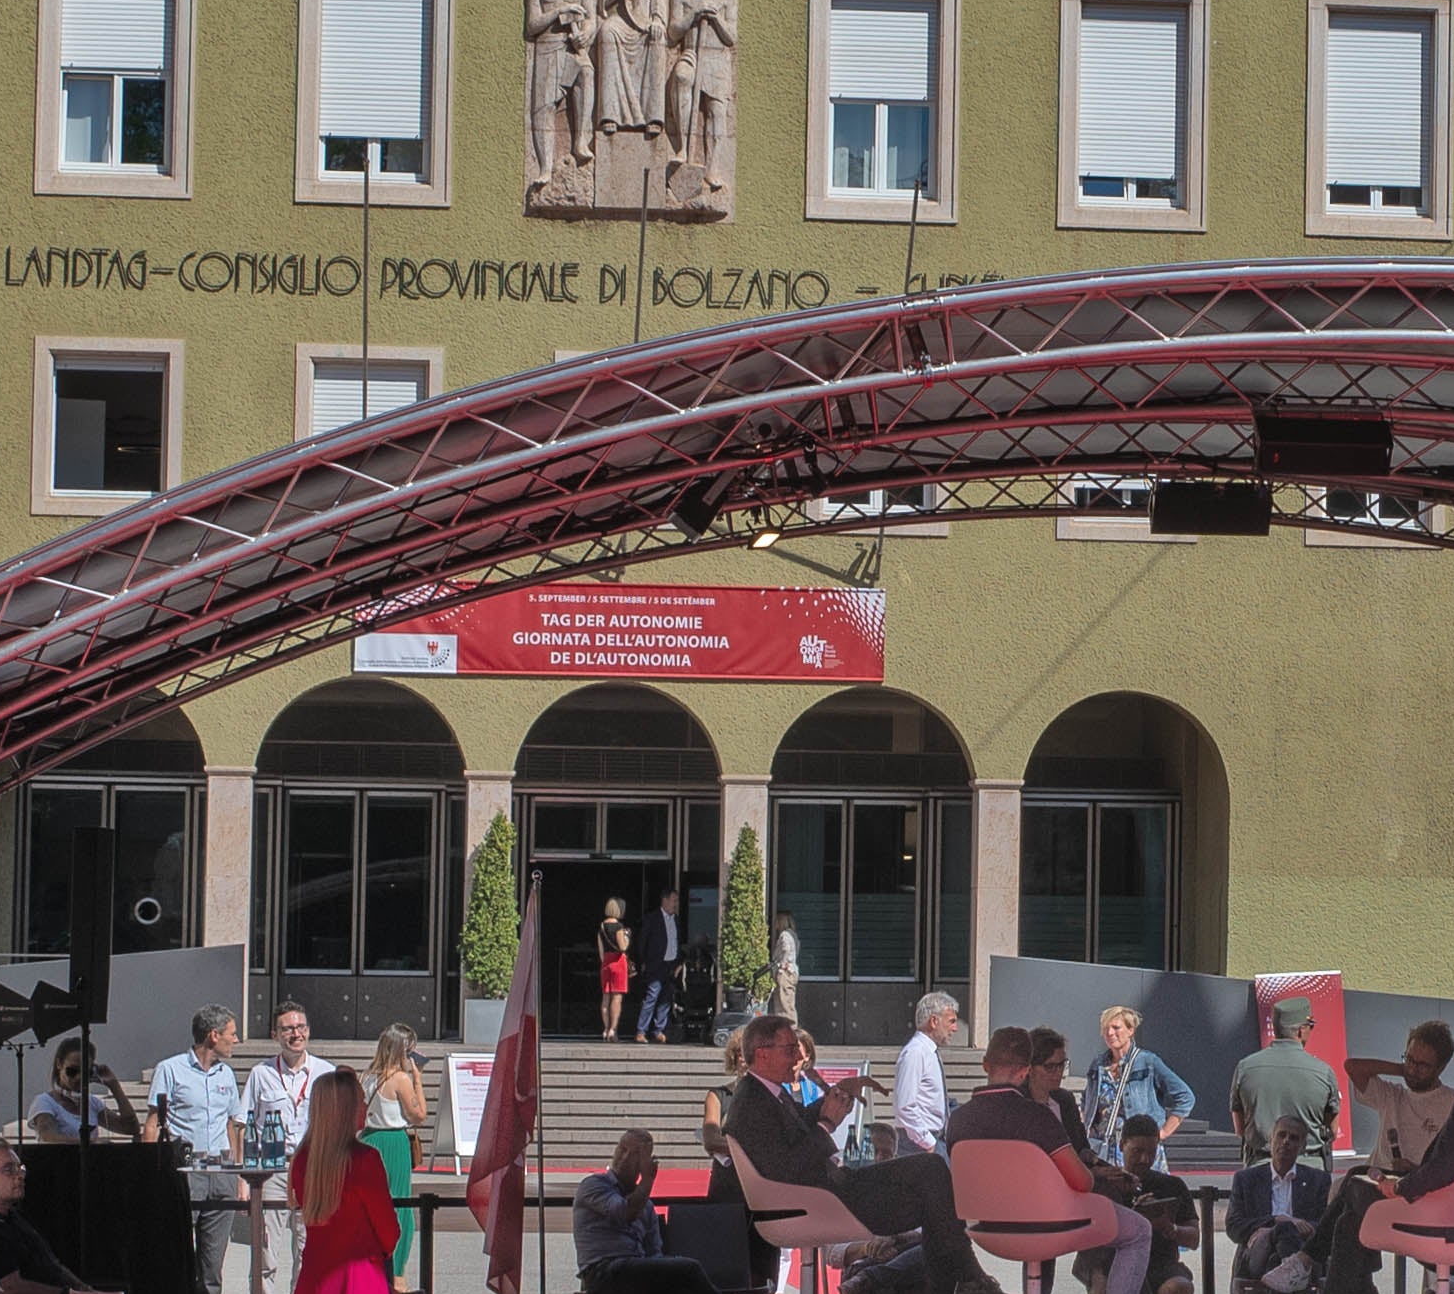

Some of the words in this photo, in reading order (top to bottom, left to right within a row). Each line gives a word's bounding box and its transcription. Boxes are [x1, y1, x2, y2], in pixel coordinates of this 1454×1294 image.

[380, 257, 579, 303] PROVINCIALE
[599, 263, 627, 306] DI
[652, 266, 830, 311] BOLZANO
[538, 595, 586, 603] SEPTEMBER
[600, 596, 647, 604] SETTEMBRE
[660, 597, 672, 605] DE
[541, 613, 571, 627] TAG
[575, 614, 605, 628] DER
[609, 615, 703, 629] AUTONOMIE
[512, 632, 591, 646] GIORNATA
[596, 633, 730, 649] DELL'AUTONOMIA
[550, 651, 570, 665] DE
[575, 652, 692, 667] DL'AUTONOMIA
